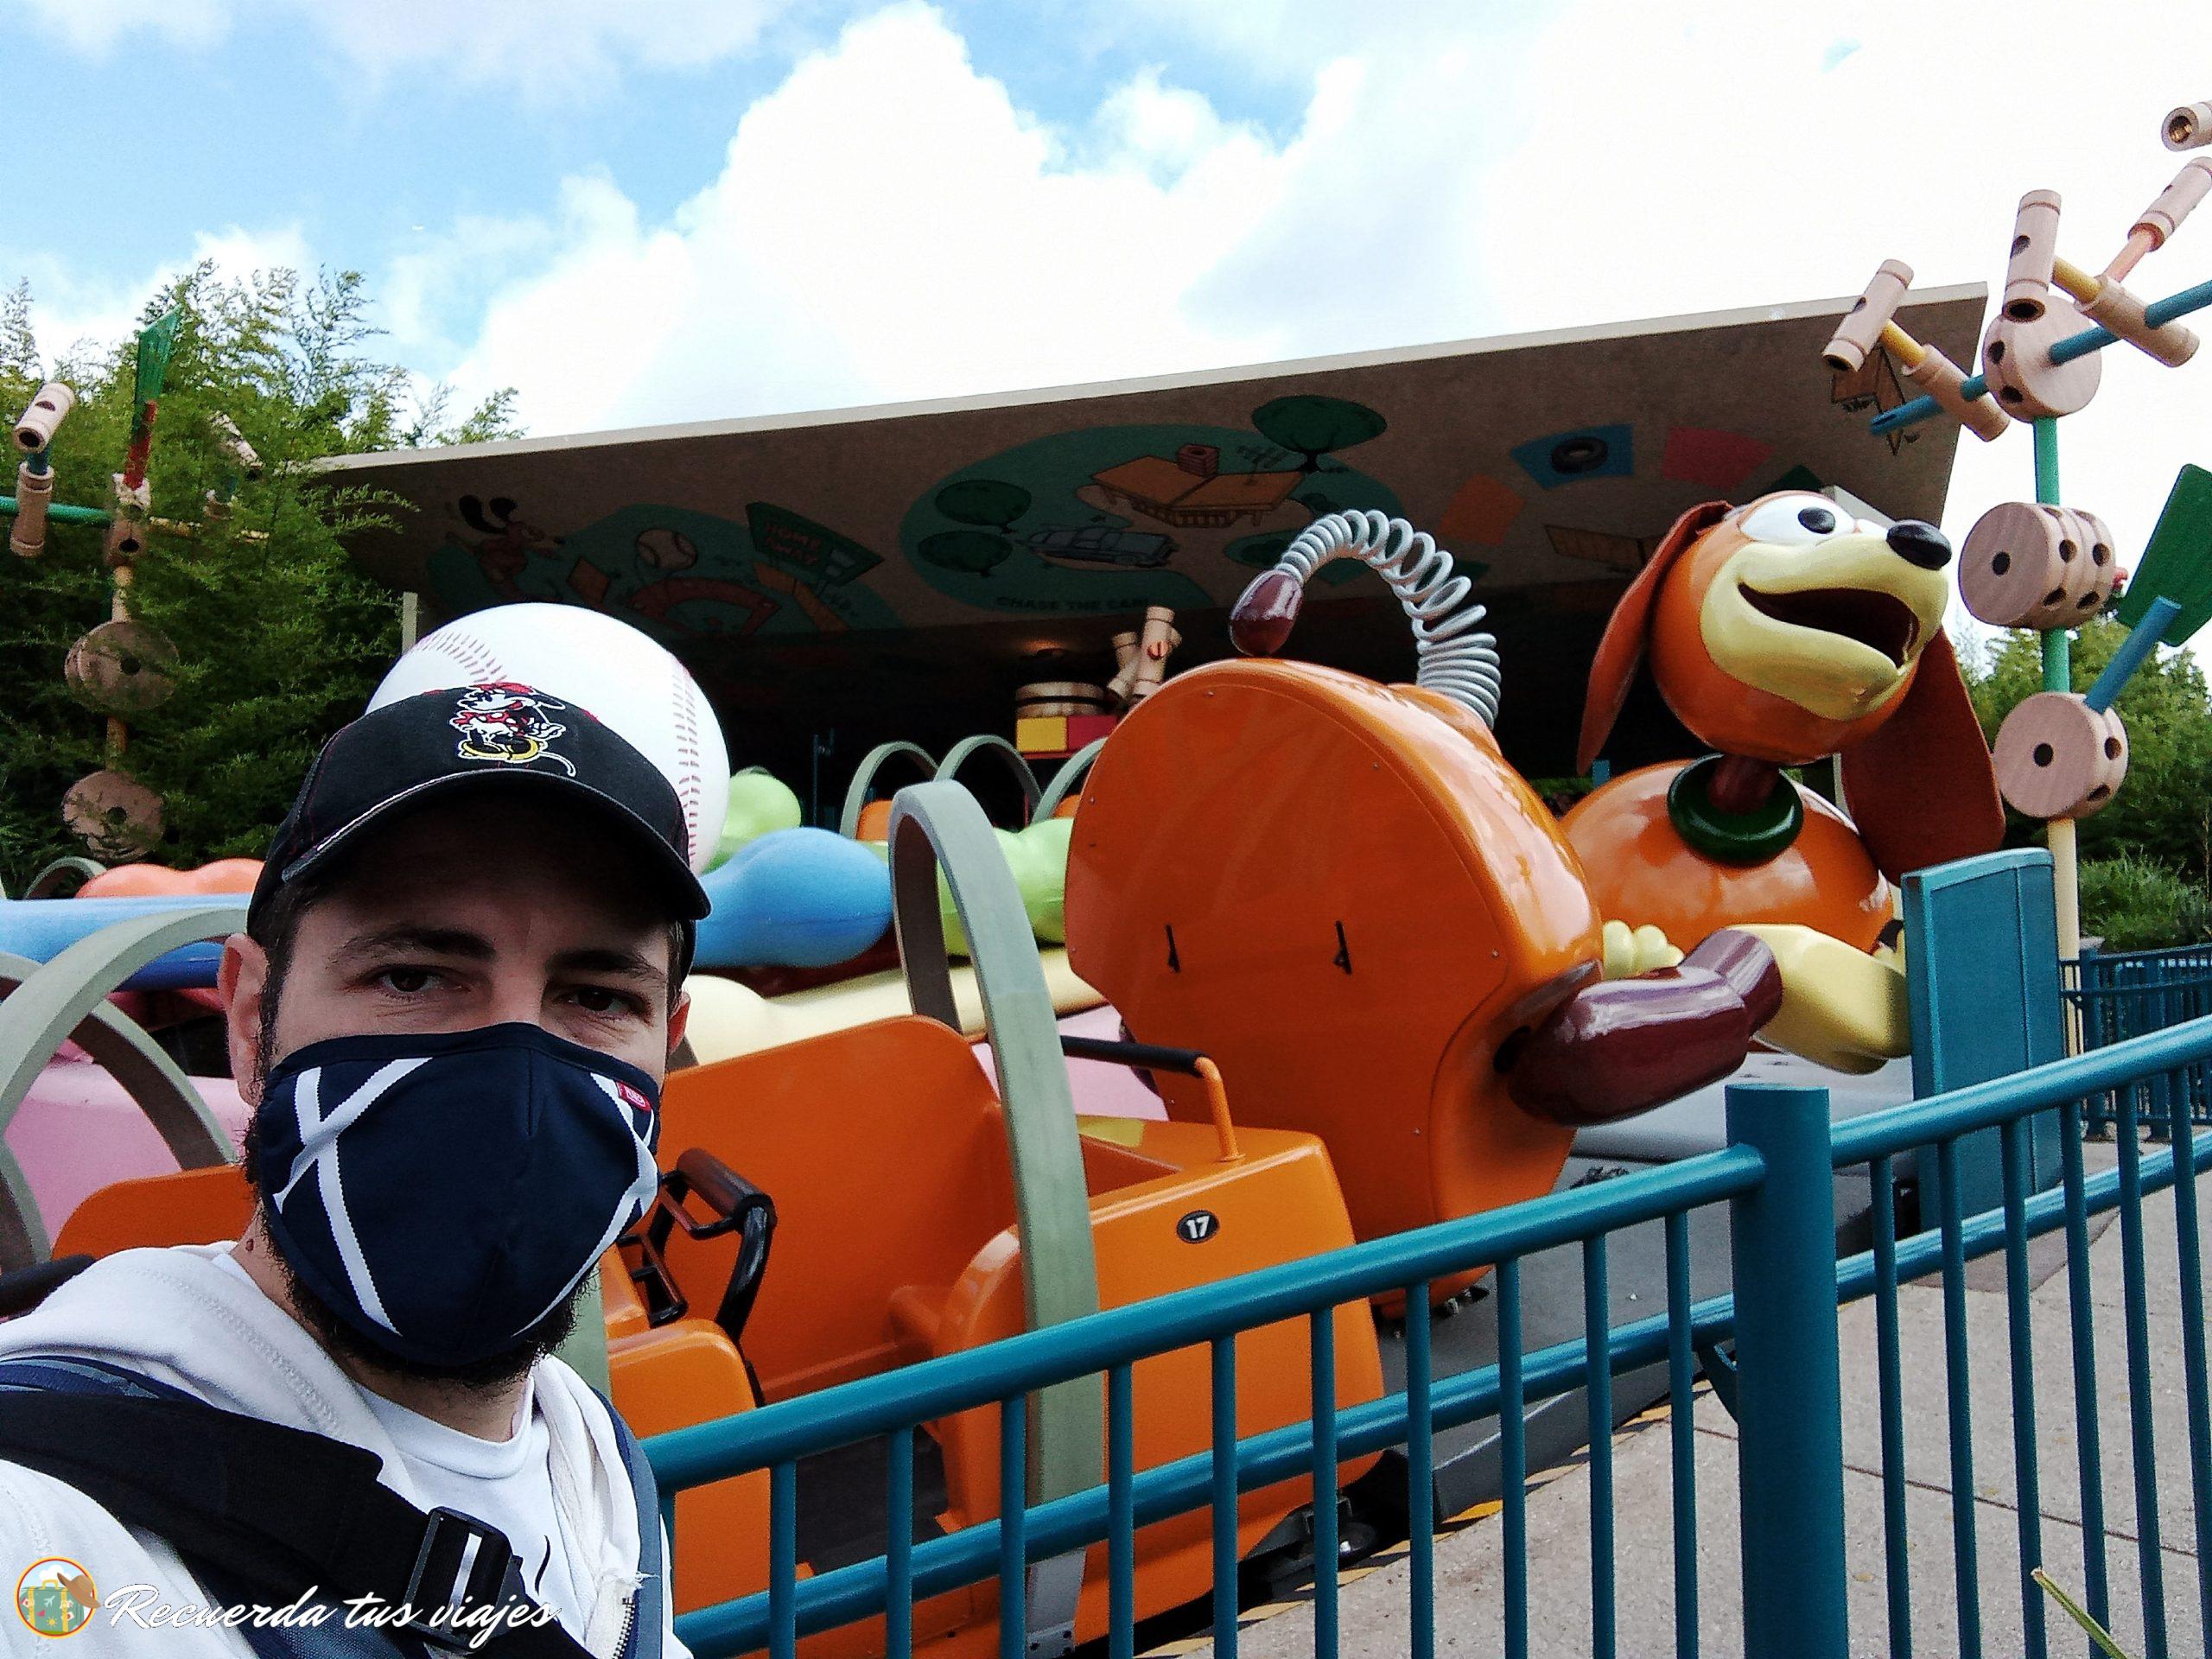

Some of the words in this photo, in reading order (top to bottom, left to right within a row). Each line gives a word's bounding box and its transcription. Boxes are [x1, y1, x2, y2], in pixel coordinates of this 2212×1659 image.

[995, 596, 1058, 610] CHASE
[1067, 600, 1102, 610] THE
[1185, 1215, 1210, 1239] 17
